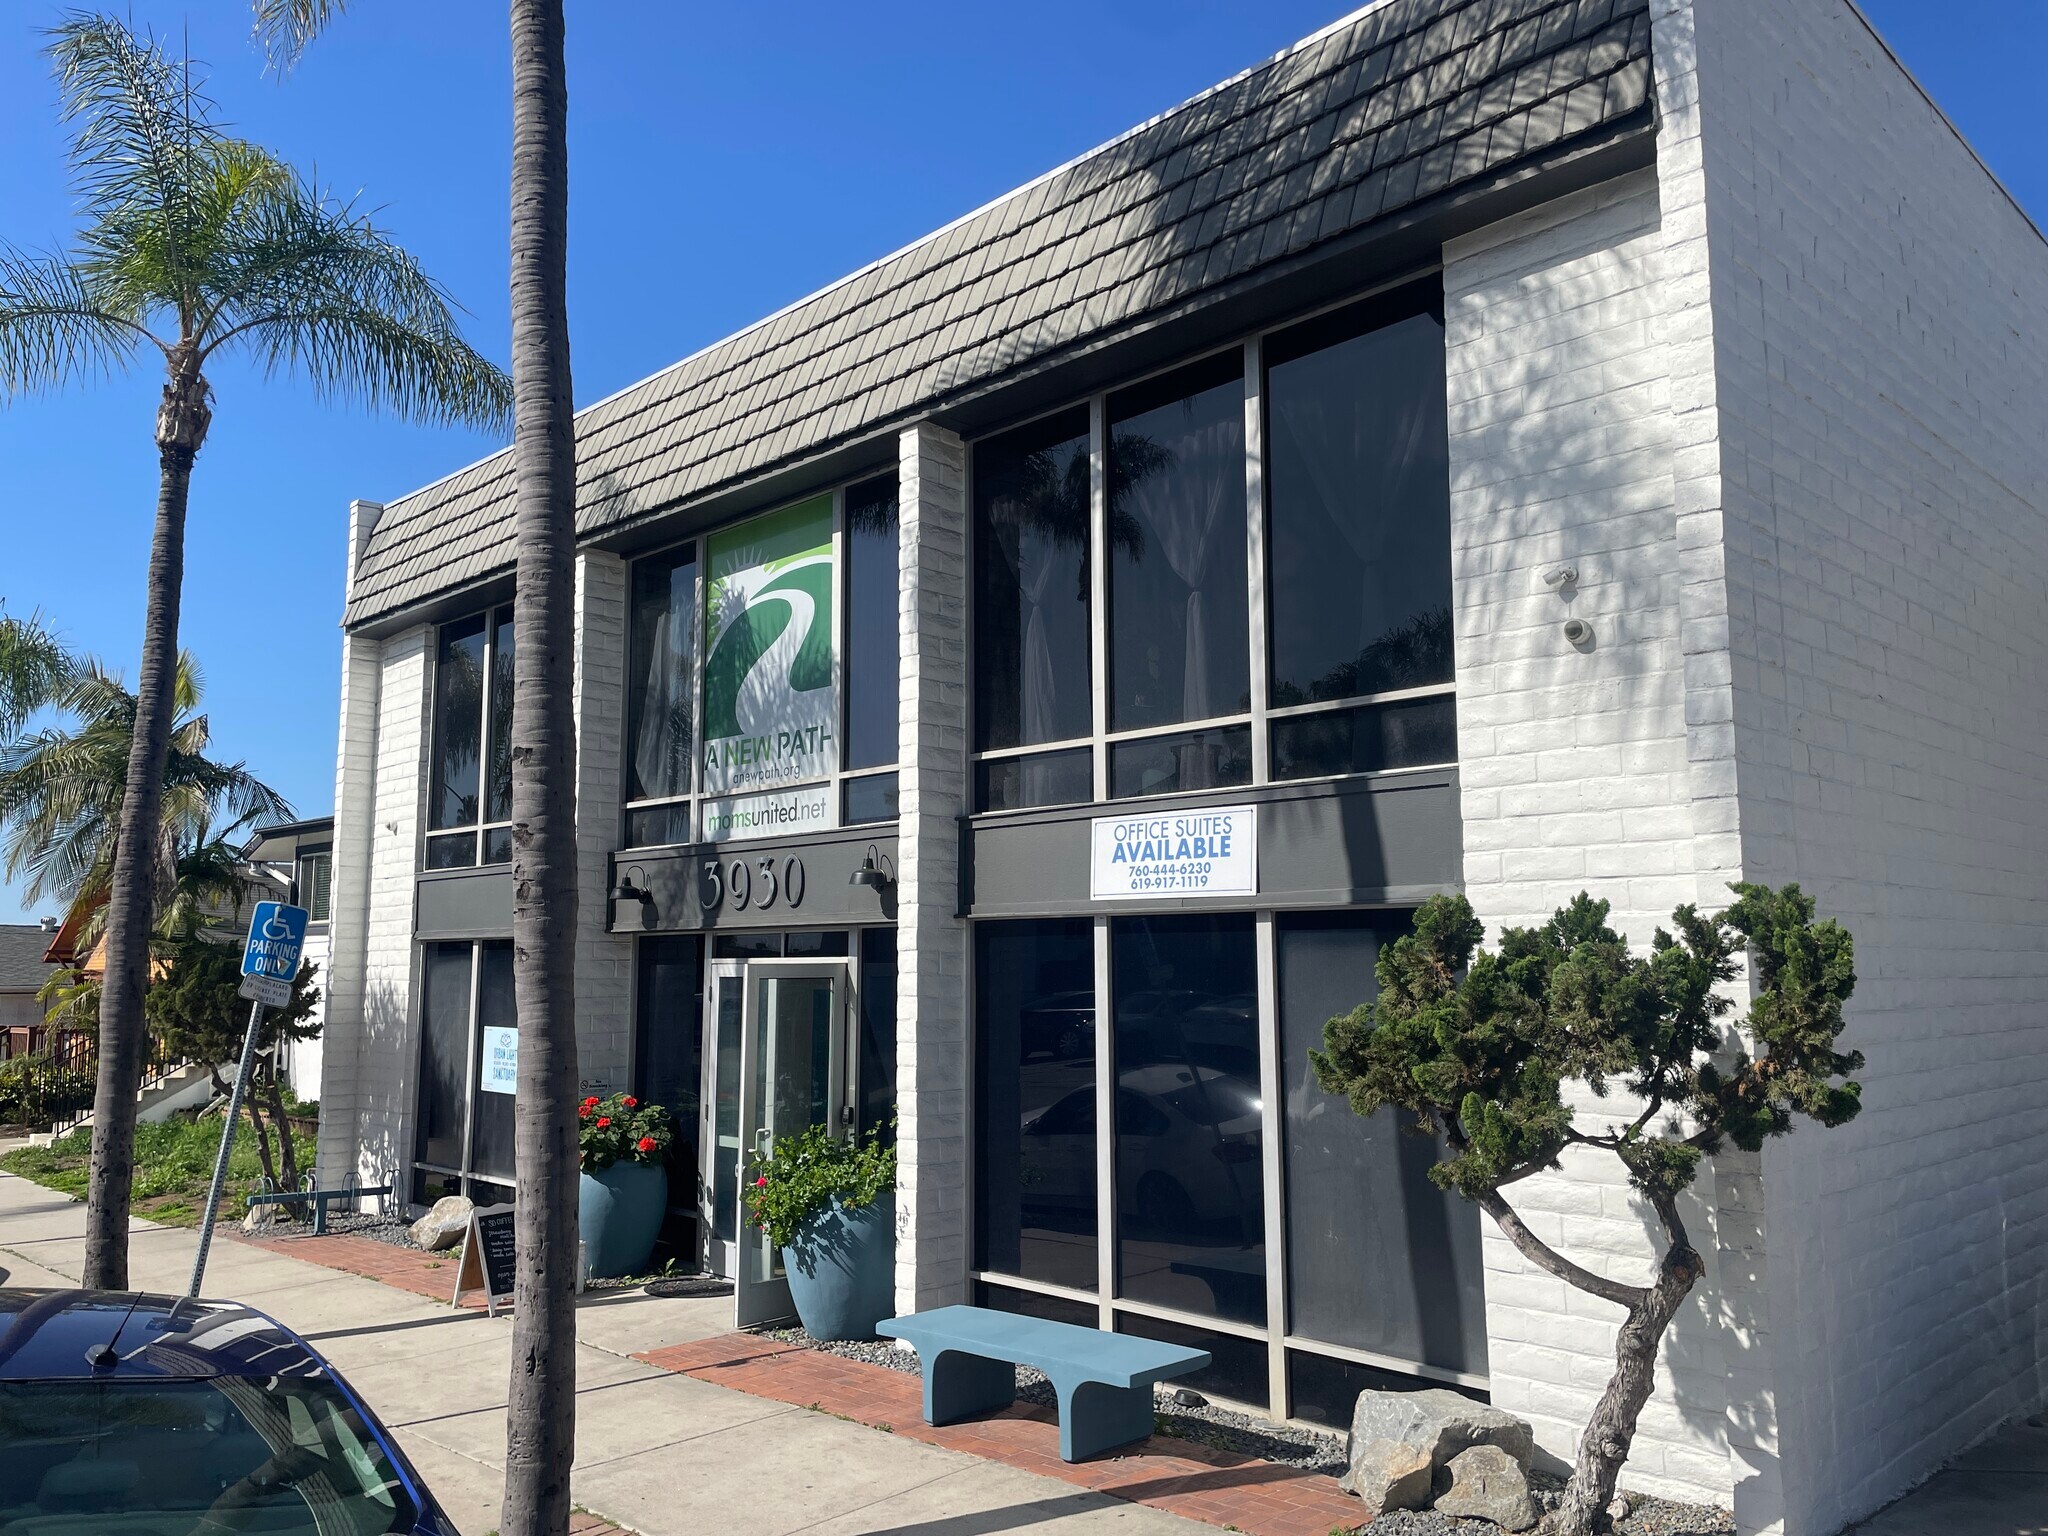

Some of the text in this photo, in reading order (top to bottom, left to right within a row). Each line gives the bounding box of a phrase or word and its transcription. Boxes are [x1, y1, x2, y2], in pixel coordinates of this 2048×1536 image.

[704, 745, 719, 770] A
[725, 734, 772, 767] NEW
[733, 763, 801, 784] anewpath.org
[708, 797, 826, 831] momsunited.net
[1114, 816, 1233, 842] OFFICE SUITES
[1112, 835, 1231, 864] AVAILABLE
[1129, 862, 1211, 878] 760-444-6230
[701, 854, 803, 911] 3930
[1131, 875, 1208, 890] 619-917-1119
[249, 939, 298, 959] PARKING
[254, 956, 282, 974] ONL
